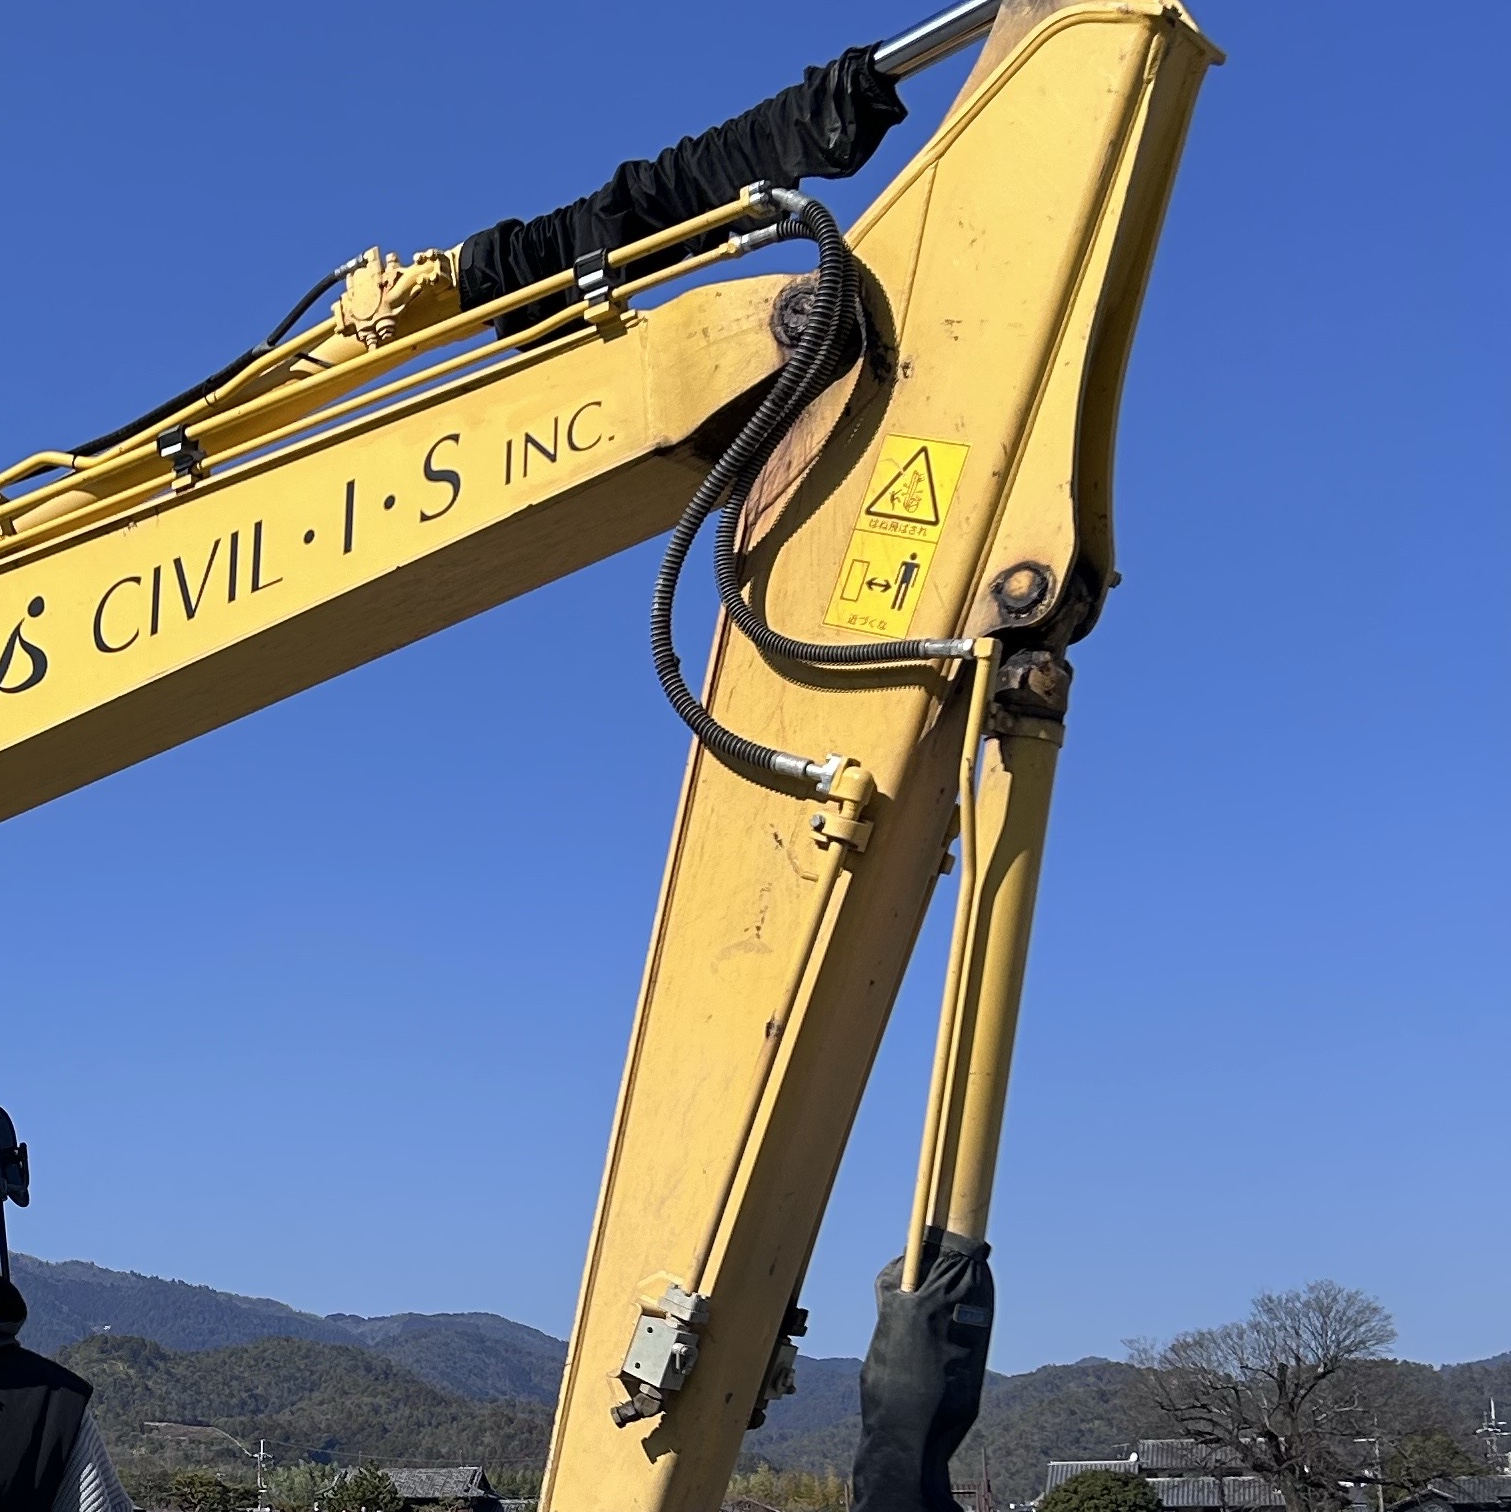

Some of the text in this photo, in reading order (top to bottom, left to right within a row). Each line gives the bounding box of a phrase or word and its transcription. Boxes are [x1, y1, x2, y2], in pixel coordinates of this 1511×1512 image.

[504, 401, 615, 486] INC.
[847, 613, 888, 631] 近づくな
